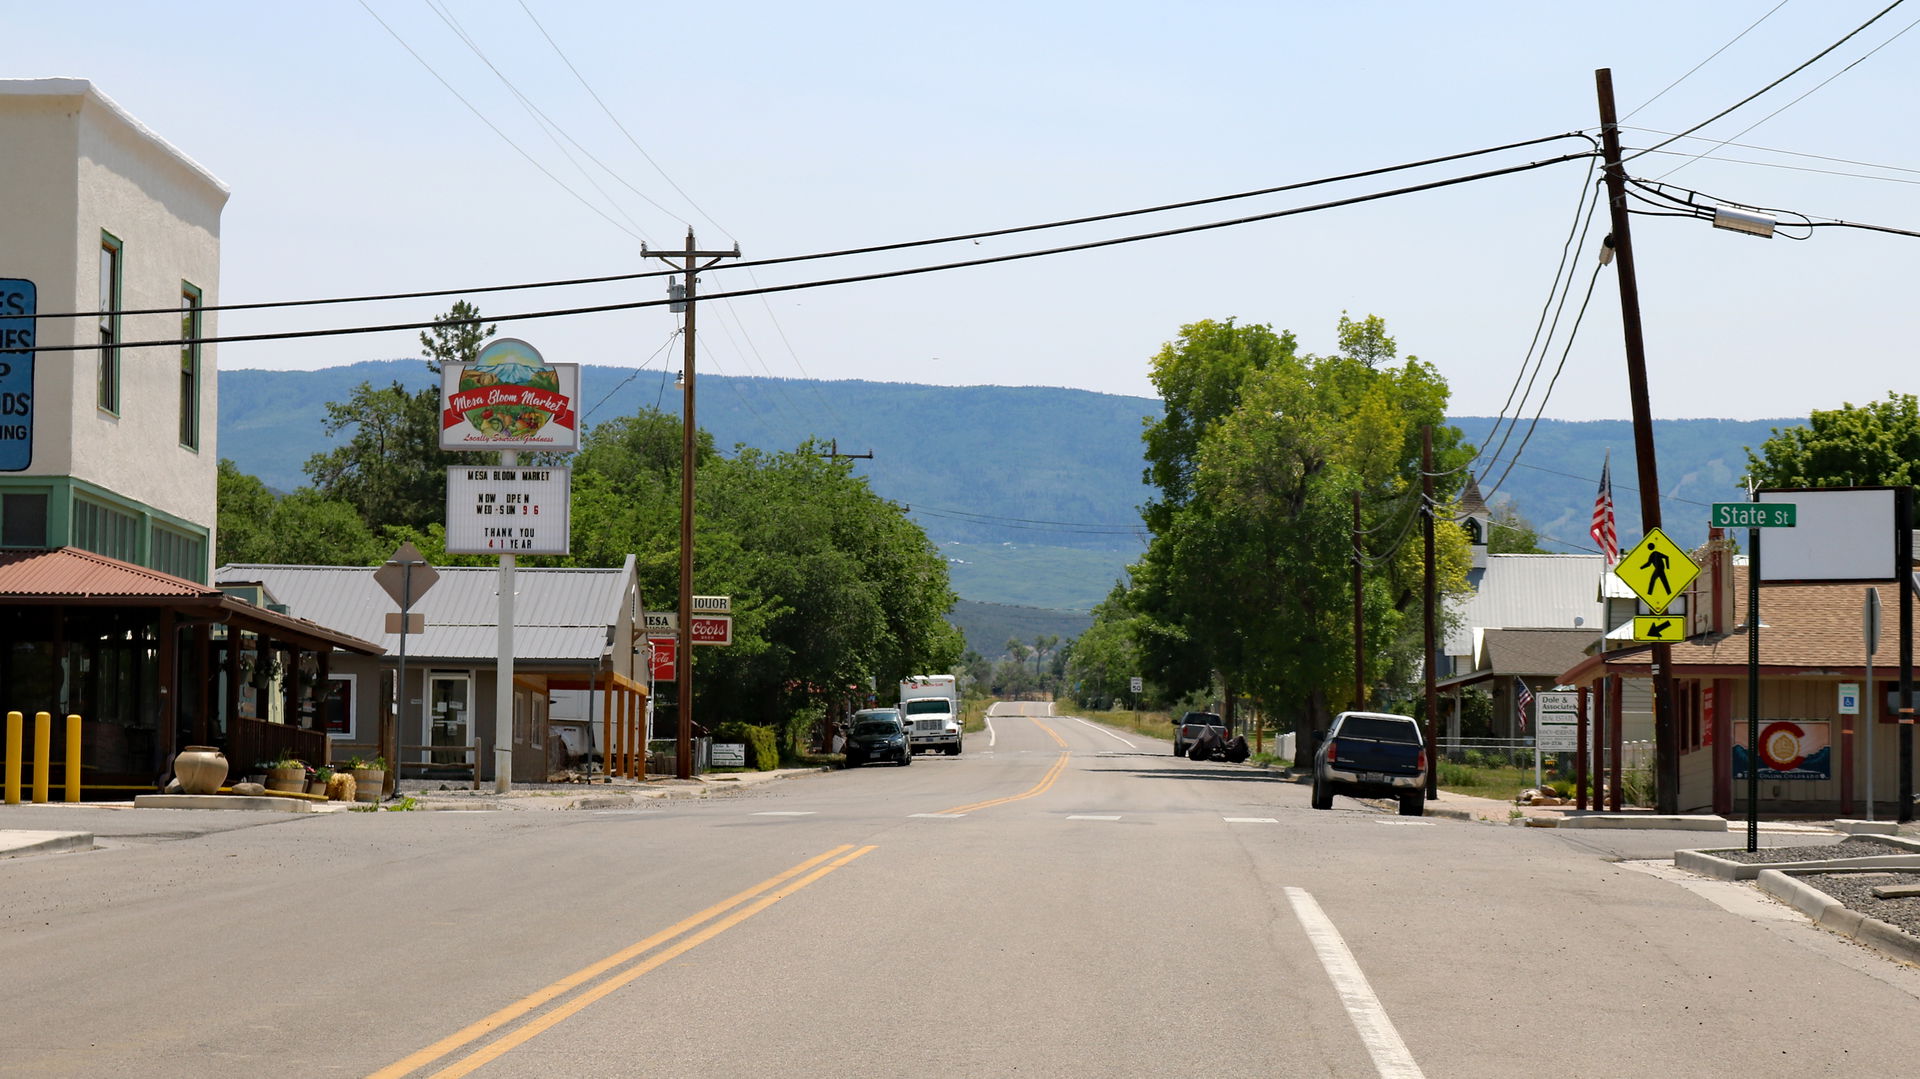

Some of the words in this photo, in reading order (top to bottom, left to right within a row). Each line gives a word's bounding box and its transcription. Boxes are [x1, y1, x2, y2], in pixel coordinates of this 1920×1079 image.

[454, 396, 483, 412] Mesa
[488, 389, 518, 405] Bloom
[521, 390, 566, 411] Market
[463, 434, 489, 443] Locally
[523, 433, 554, 444] Goodness
[467, 471, 488, 481] MESA
[493, 471, 516, 481] BLOOM
[522, 471, 550, 481] MARKET
[478, 494, 497, 503] NOW
[506, 494, 530, 503] OPEN
[1720, 506, 1767, 525] State
[1774, 510, 1789, 525] St
[484, 528, 513, 538] THANK
[520, 528, 535, 538] YOU
[510, 540, 532, 549] YEAR
[692, 621, 725, 636] Coors
